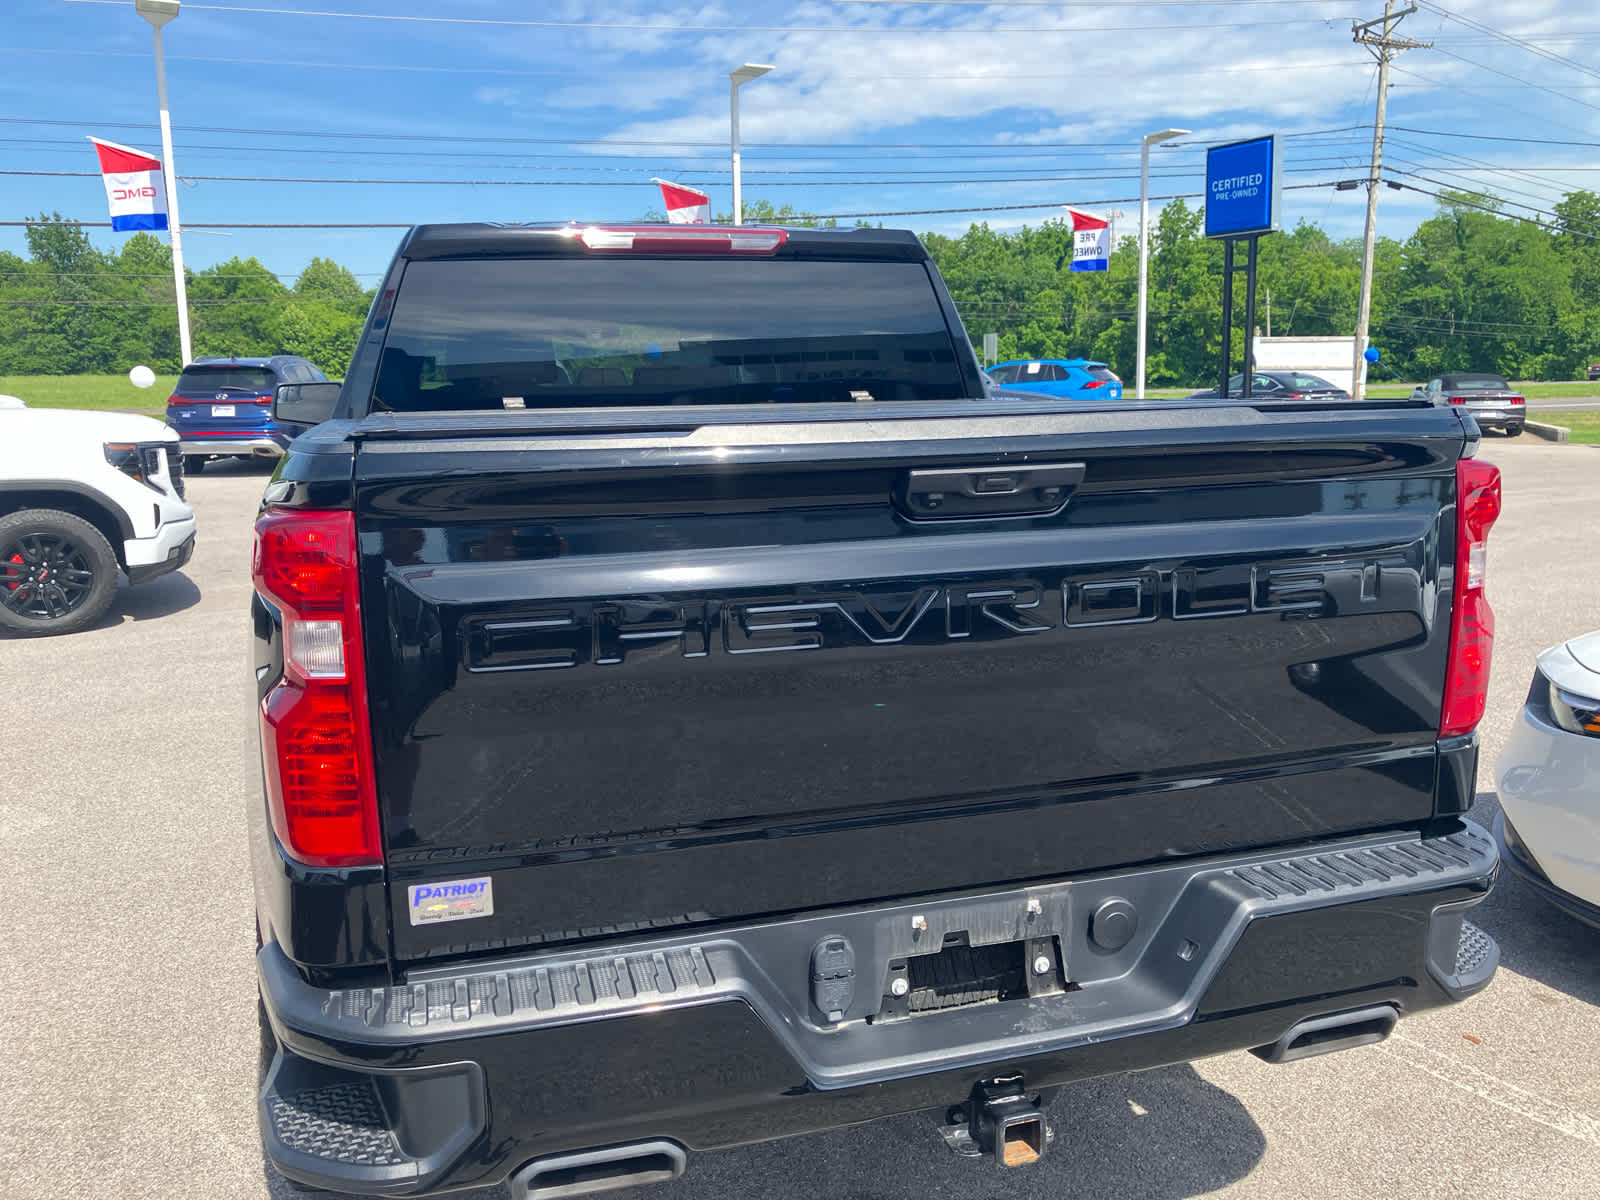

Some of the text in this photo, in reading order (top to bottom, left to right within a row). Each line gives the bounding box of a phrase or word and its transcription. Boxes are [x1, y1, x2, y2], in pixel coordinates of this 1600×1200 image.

[1212, 173, 1263, 192] CERTIFIED
[1215, 187, 1258, 200] PRE-OWNED
[463, 553, 1406, 672] CHEVROLET
